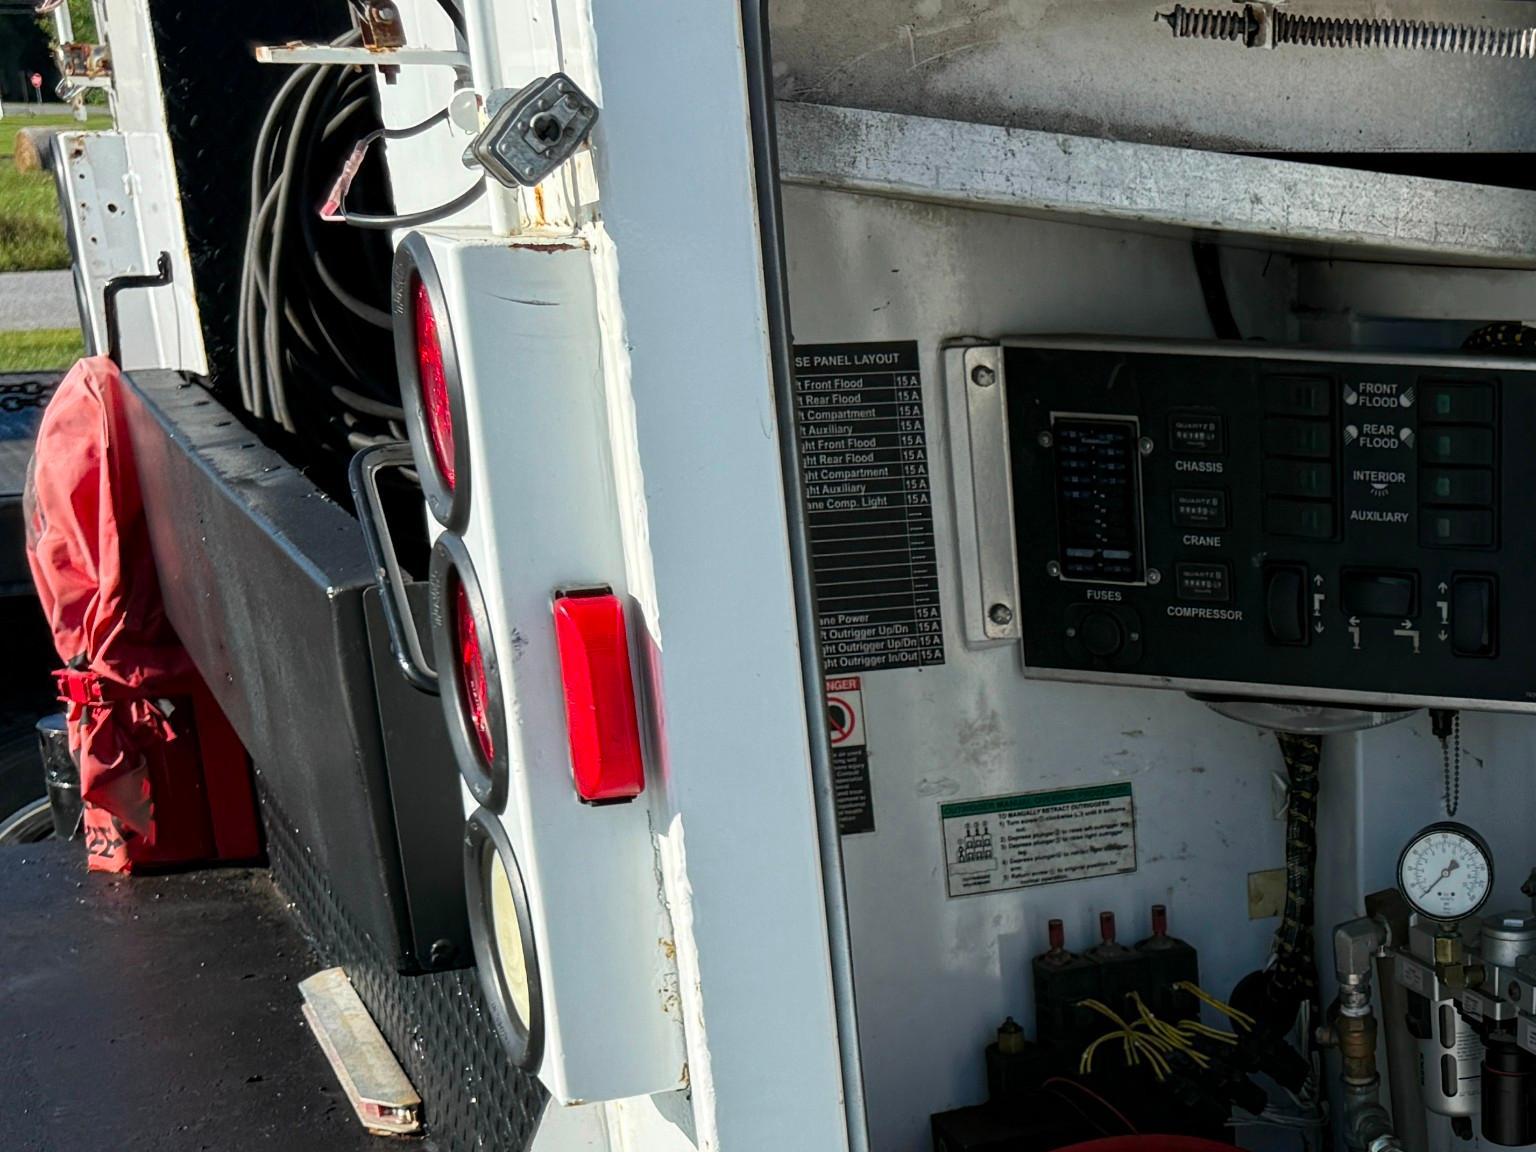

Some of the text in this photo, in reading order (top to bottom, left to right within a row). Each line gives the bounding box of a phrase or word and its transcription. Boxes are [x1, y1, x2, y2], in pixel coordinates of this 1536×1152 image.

[795, 353, 900, 367] SE PANEL LAYOUT
[805, 380, 831, 390] Front
[835, 378, 863, 389] Flood
[1359, 382, 1398, 395] FRONT
[806, 395, 828, 405] Rear
[832, 394, 861, 404] Flood
[1359, 396, 1398, 408] FLOOD
[808, 408, 876, 421] Compartment
[809, 424, 852, 435] Auxiliary
[1363, 424, 1395, 435] REAR
[818, 439, 845, 450] Front
[848, 438, 876, 448] Flood
[1359, 437, 1398, 449] FLOOD
[820, 454, 842, 464] Rear
[846, 453, 874, 463] Flood
[1175, 460, 1223, 473] CHASSIS
[821, 467, 888, 480] Compartment
[1353, 470, 1406, 483] INTERIOR
[822, 483, 866, 495] Auxiliary
[862, 496, 888, 508] Light
[1351, 510, 1409, 523] AUXILIARY
[1183, 535, 1221, 547] CRANE
[1087, 589, 1122, 601] FUSES
[838, 614, 869, 623] Power
[1167, 606, 1243, 620] COMPRESSOR
[830, 628, 876, 640] Outrigger
[878, 625, 909, 636] Up/Dn
[838, 641, 885, 653] Outrigger
[887, 638, 917, 649] Up/Dn
[840, 655, 886, 667] Outrigger
[889, 652, 918, 662] In/Out
[826, 680, 857, 690] NGER
